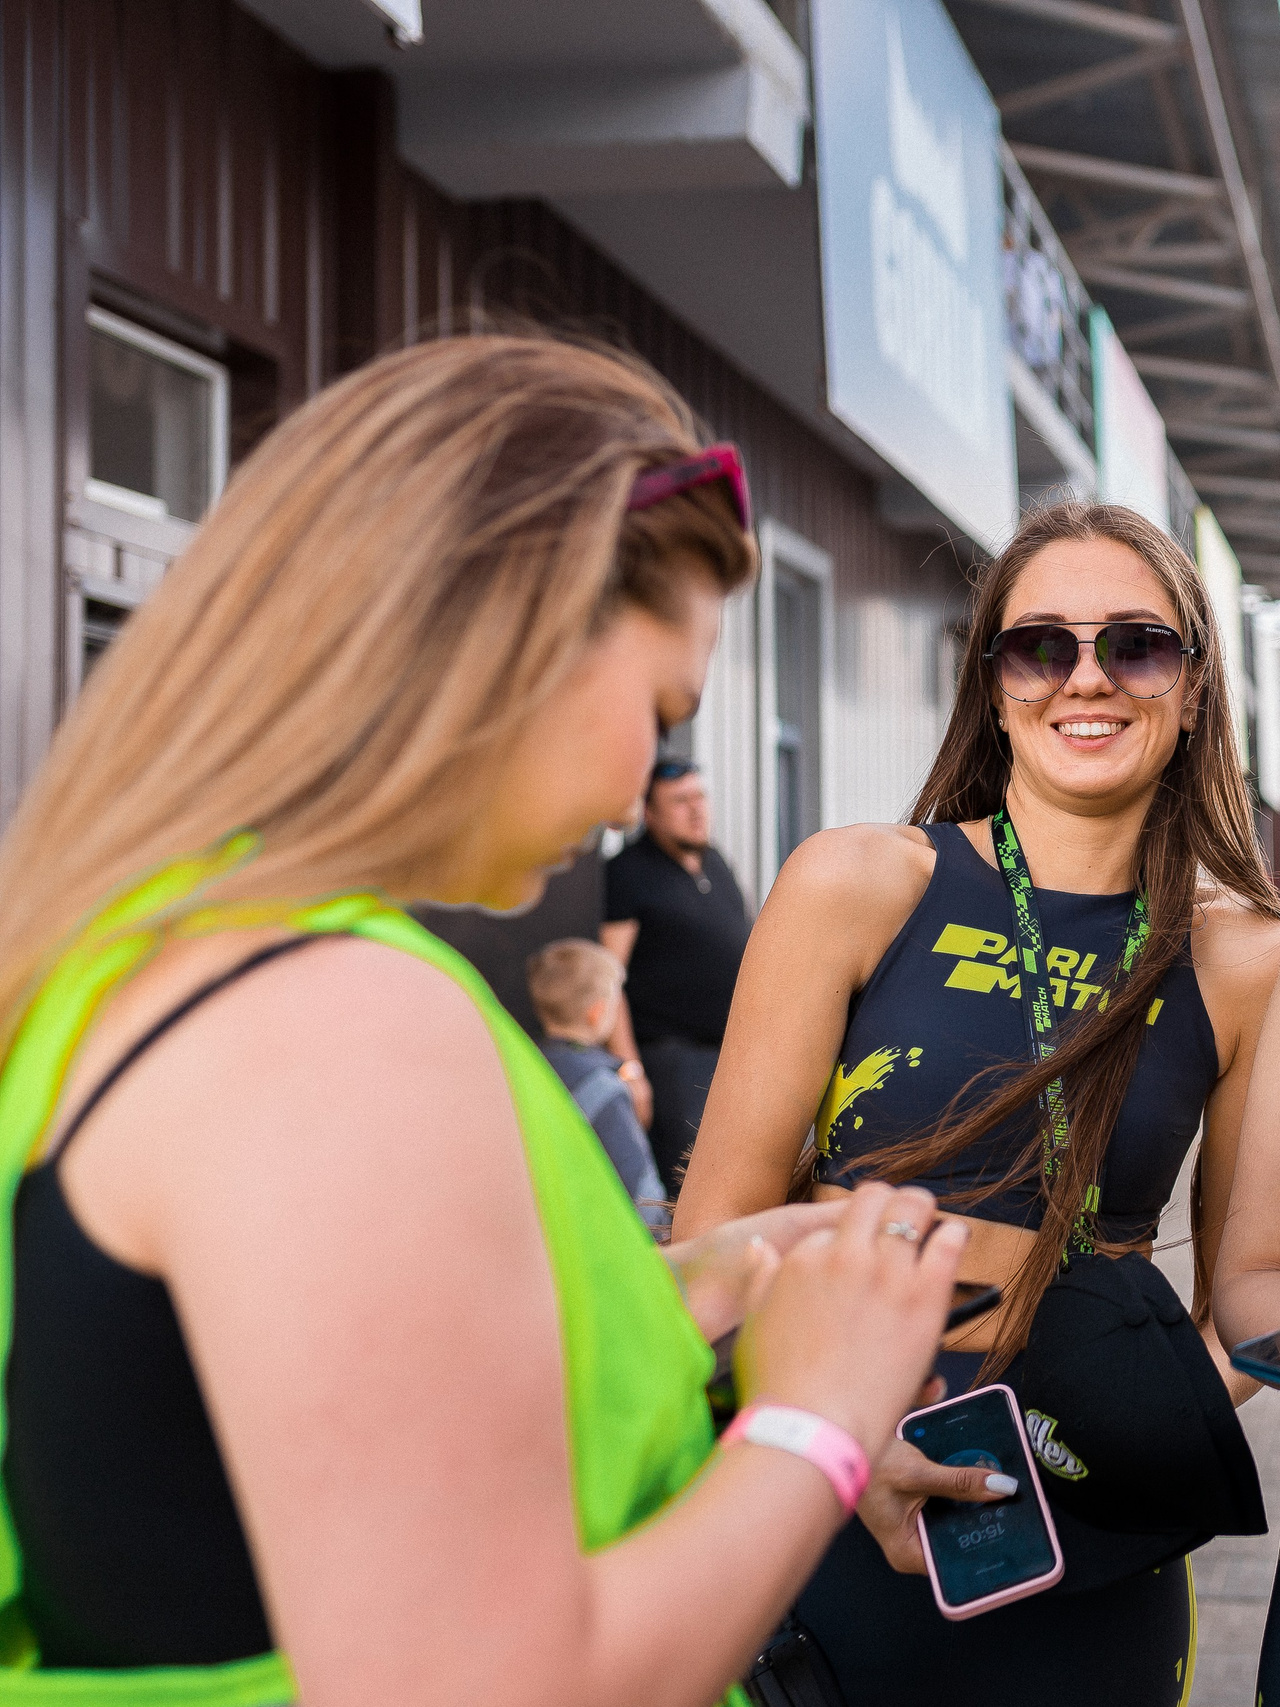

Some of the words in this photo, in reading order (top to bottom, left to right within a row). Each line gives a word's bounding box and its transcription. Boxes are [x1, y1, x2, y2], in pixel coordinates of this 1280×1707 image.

[1032, 1001, 1045, 1033] PARI
[1038, 986, 1052, 1029] MATCH
[958, 1522, 1006, 1549] 15:08
